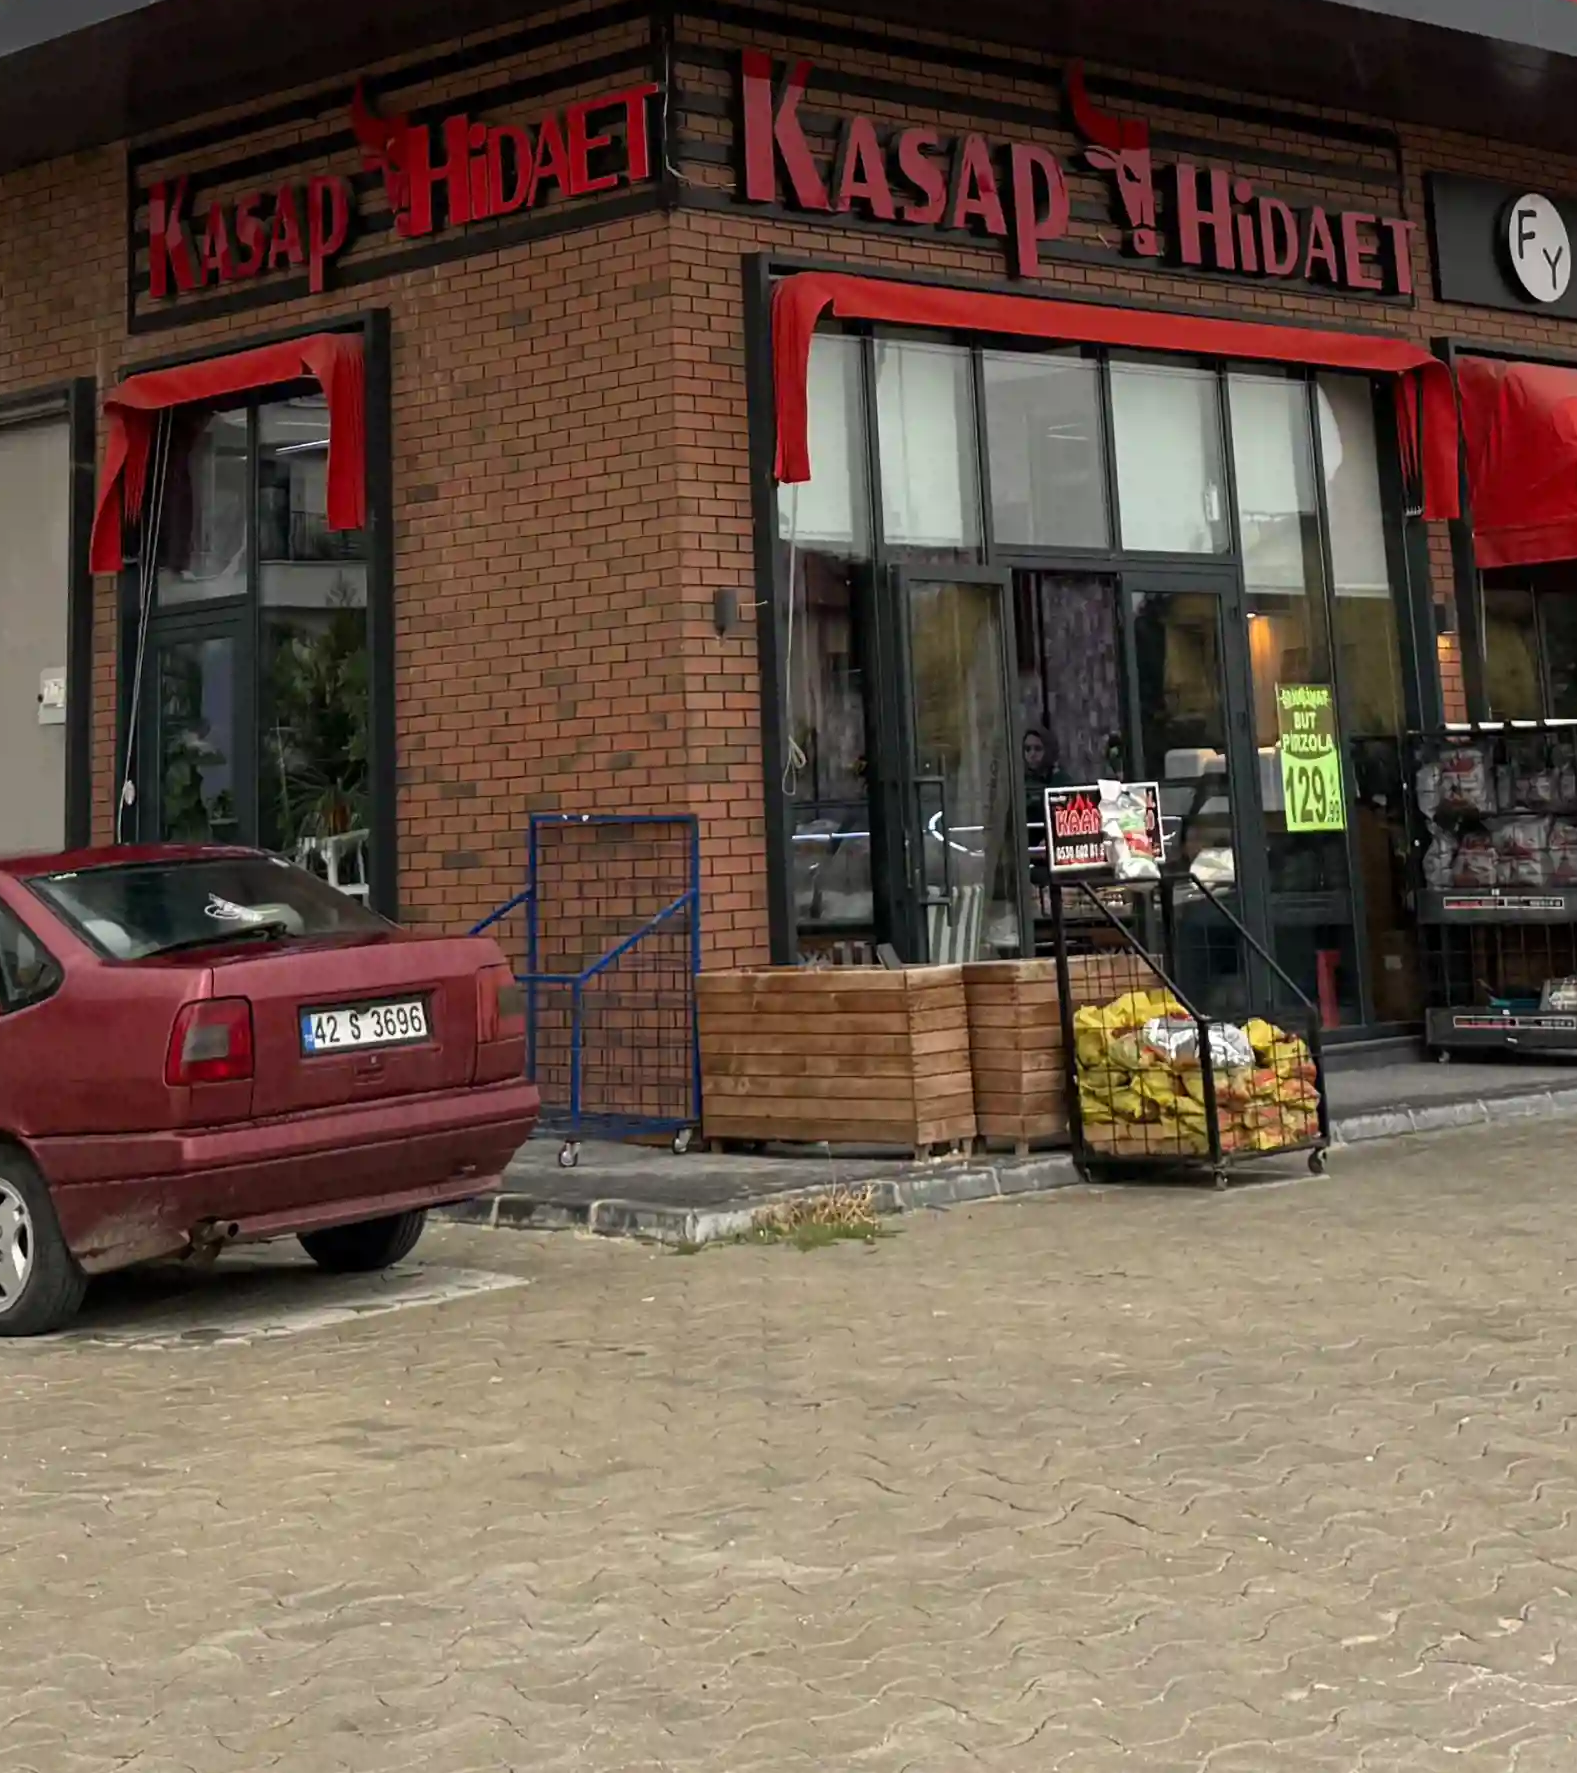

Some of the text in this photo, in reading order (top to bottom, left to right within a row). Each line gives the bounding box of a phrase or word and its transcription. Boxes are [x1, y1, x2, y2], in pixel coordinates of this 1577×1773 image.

[742, 46, 1070, 277] KASAP
[148, 172, 349, 298] KASAP
[1293, 711, 1317, 730] BUT
[1282, 730, 1335, 753] PİRZOLA
[315, 1015, 340, 1044] 42
[349, 1013, 361, 1040] S
[371, 1006, 423, 1037] 3696
